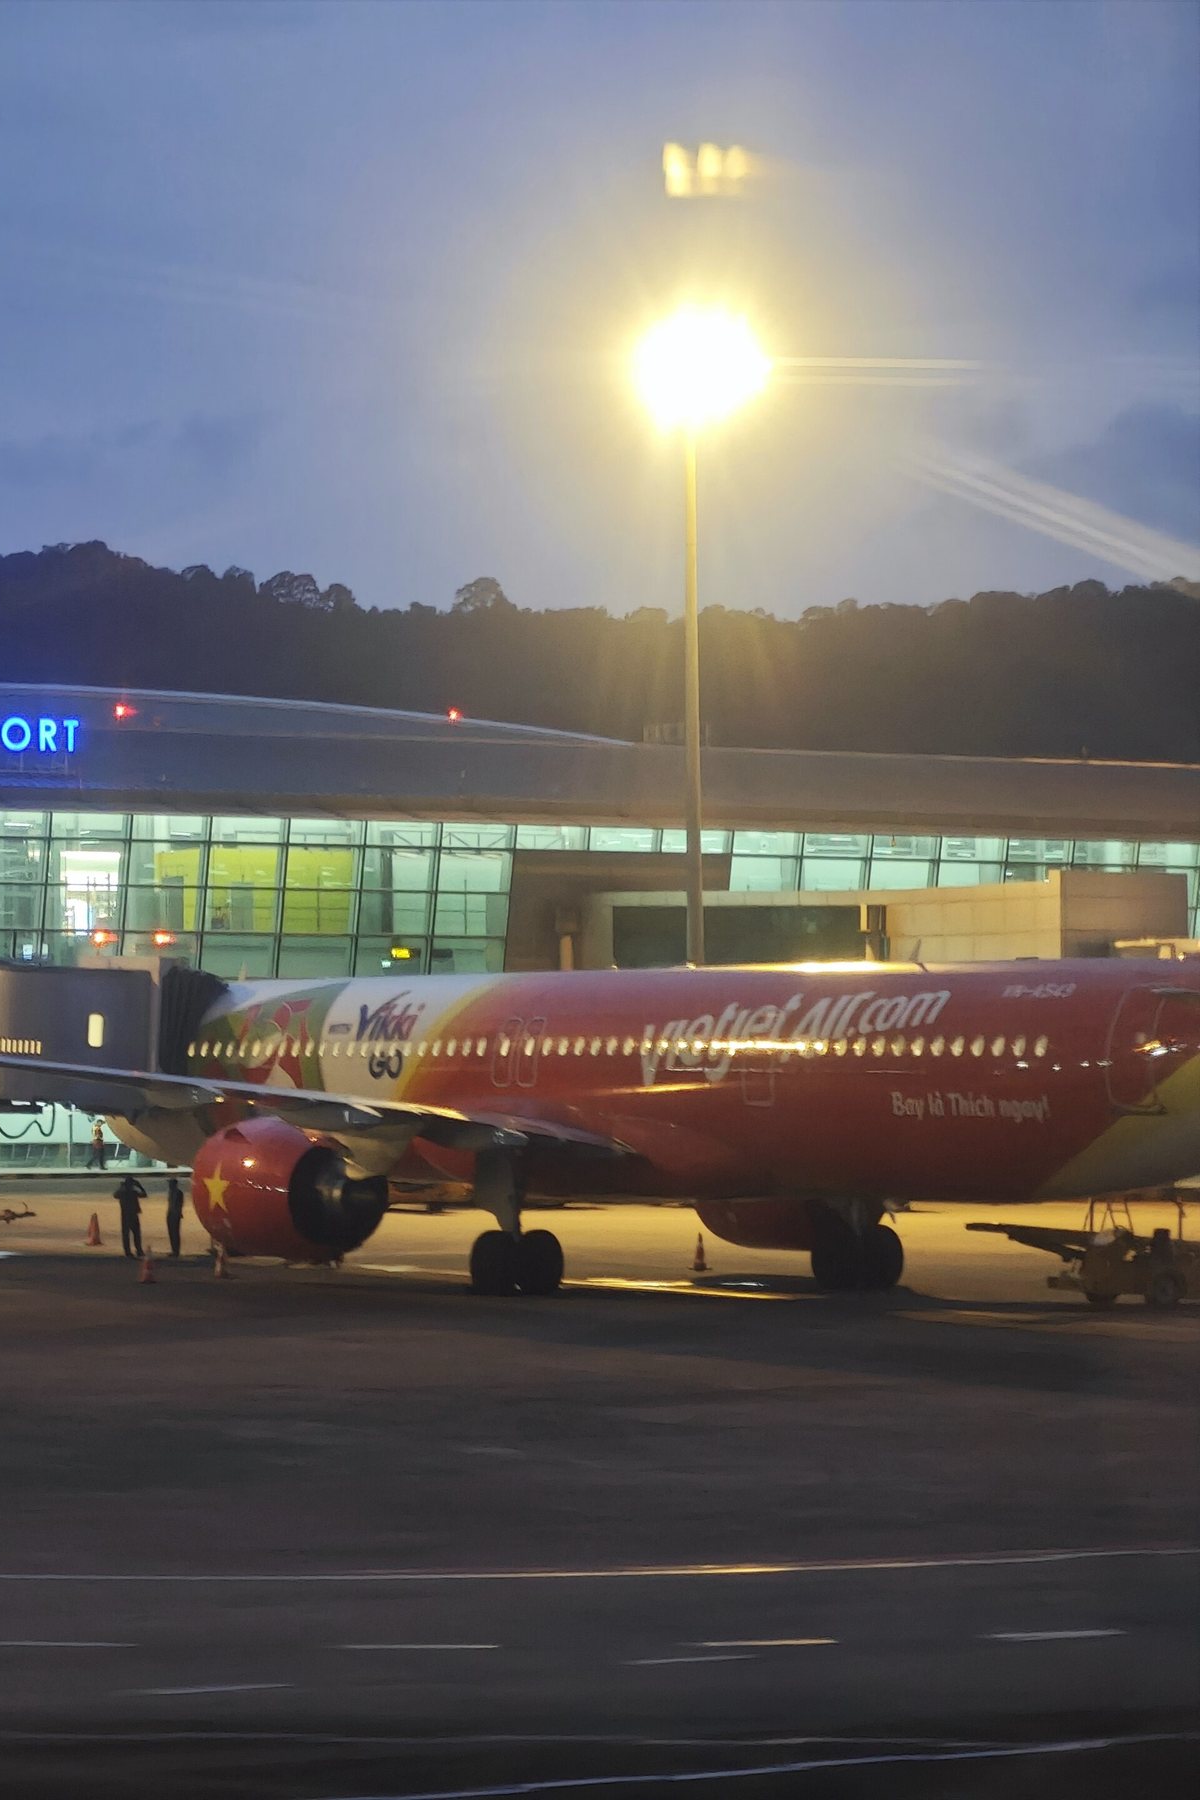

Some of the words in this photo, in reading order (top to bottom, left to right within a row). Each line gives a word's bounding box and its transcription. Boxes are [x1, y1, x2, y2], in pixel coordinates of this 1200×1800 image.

[356, 989, 425, 1041] Vikki
[368, 1049, 403, 1079] GO
[891, 1091, 924, 1120] Bay
